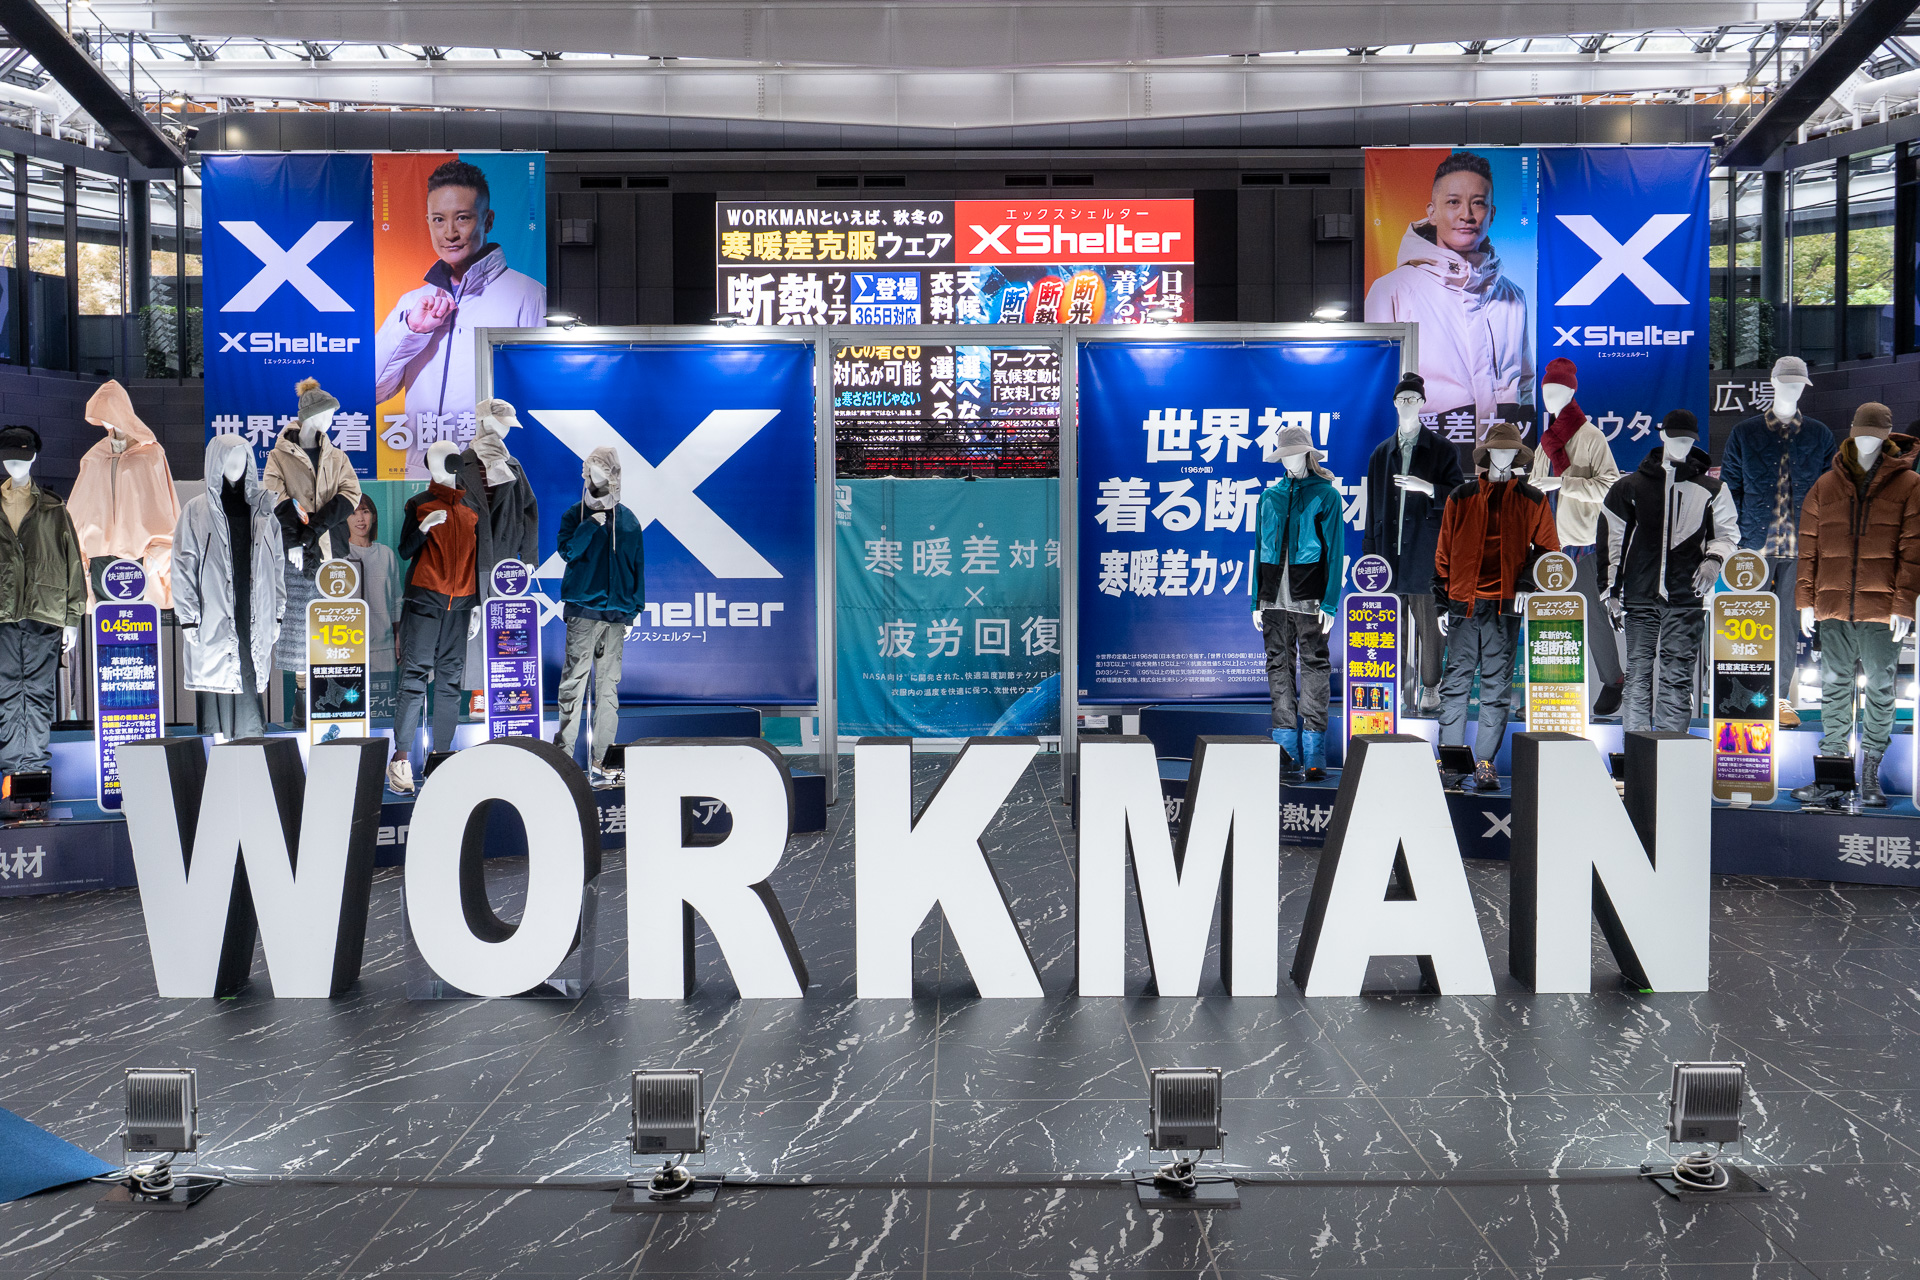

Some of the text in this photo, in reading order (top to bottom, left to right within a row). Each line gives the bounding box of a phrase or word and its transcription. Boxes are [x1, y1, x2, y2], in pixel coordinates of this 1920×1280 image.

[727, 208, 944, 226] WORKMANといえば、秋冬の
[1006, 208, 1149, 220] エックスシェルター
[721, 230, 952, 261] 寒暖差克服ウェア
[101, 619, 152, 632] 0.45mm
[877, 615, 1060, 659] 疲労回復
[1349, 632, 1395, 649] 寒暖差
[1367, 649, 1377, 660] を
[1349, 661, 1395, 678] 無効化
[118, 737, 1711, 999] WORKMAN
